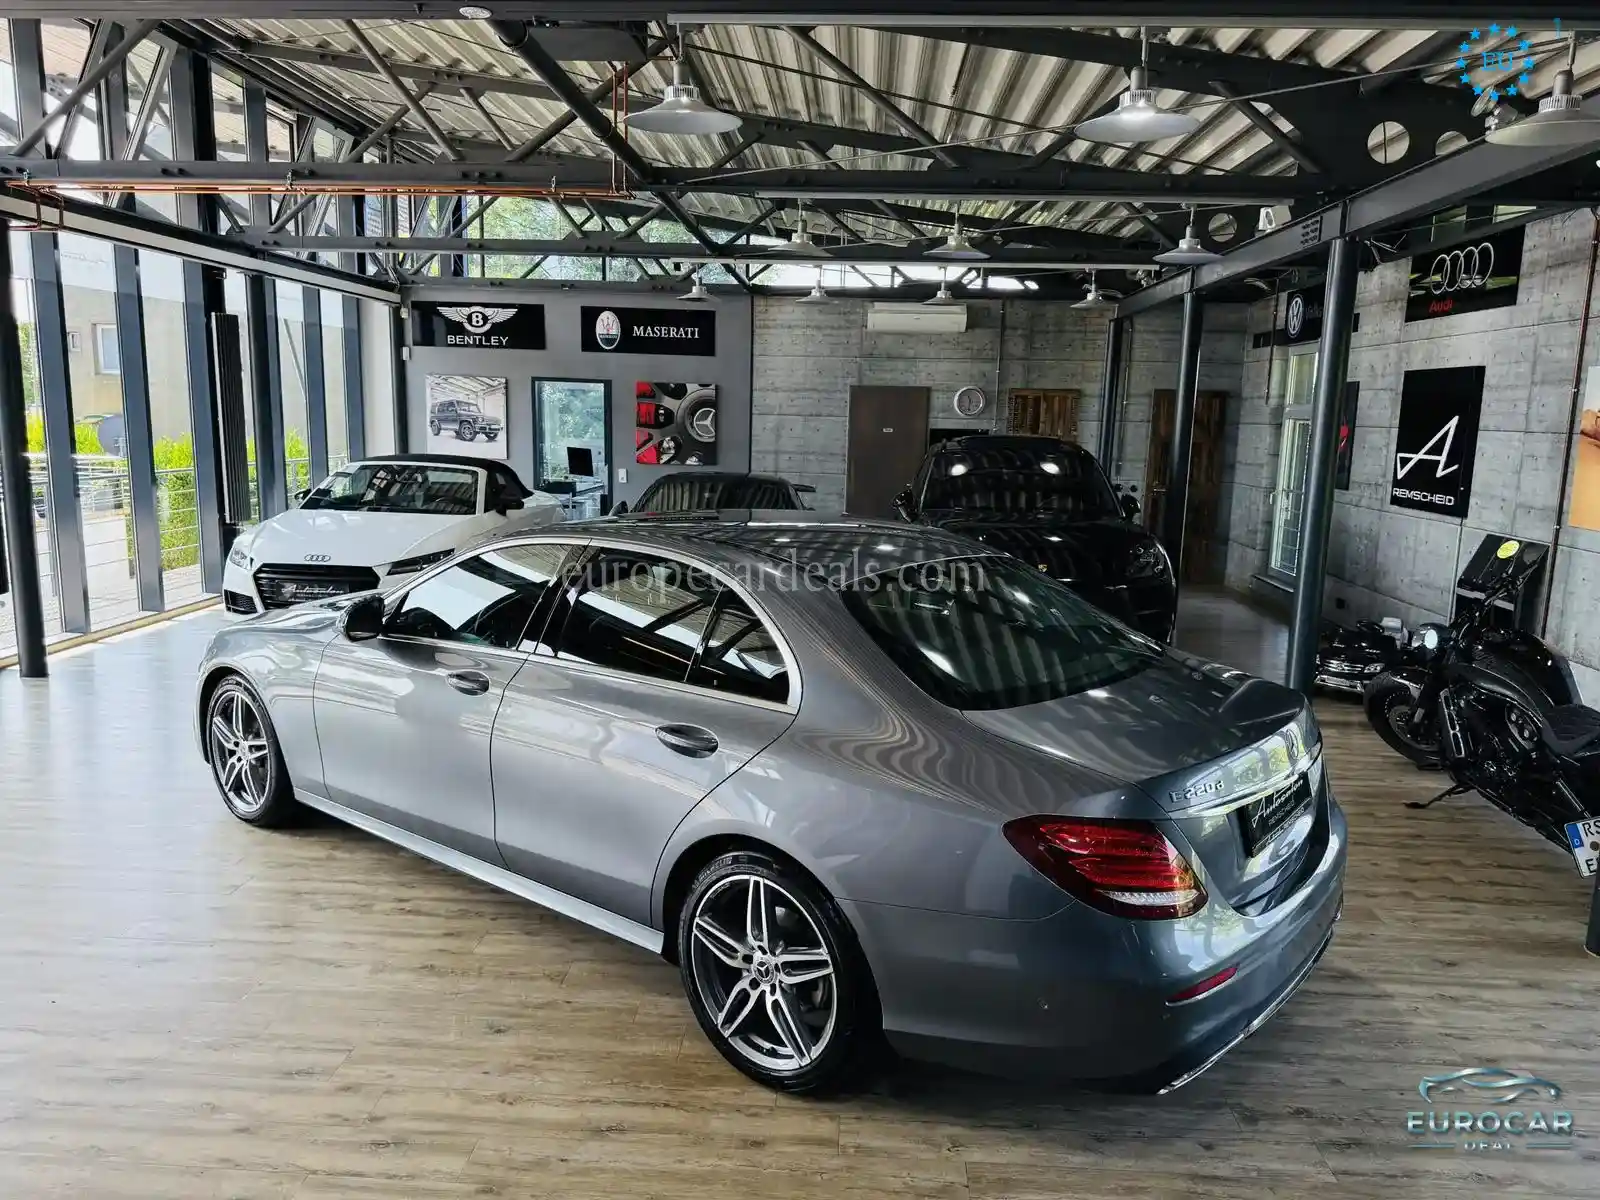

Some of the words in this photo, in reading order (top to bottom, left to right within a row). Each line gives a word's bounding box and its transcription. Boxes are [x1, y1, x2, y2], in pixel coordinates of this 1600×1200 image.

[1428, 298, 1454, 313] Audi
[632, 325, 700, 339] MASERATI
[447, 334, 509, 347] BENTLEY
[1392, 487, 1455, 506] REMSCHEID
